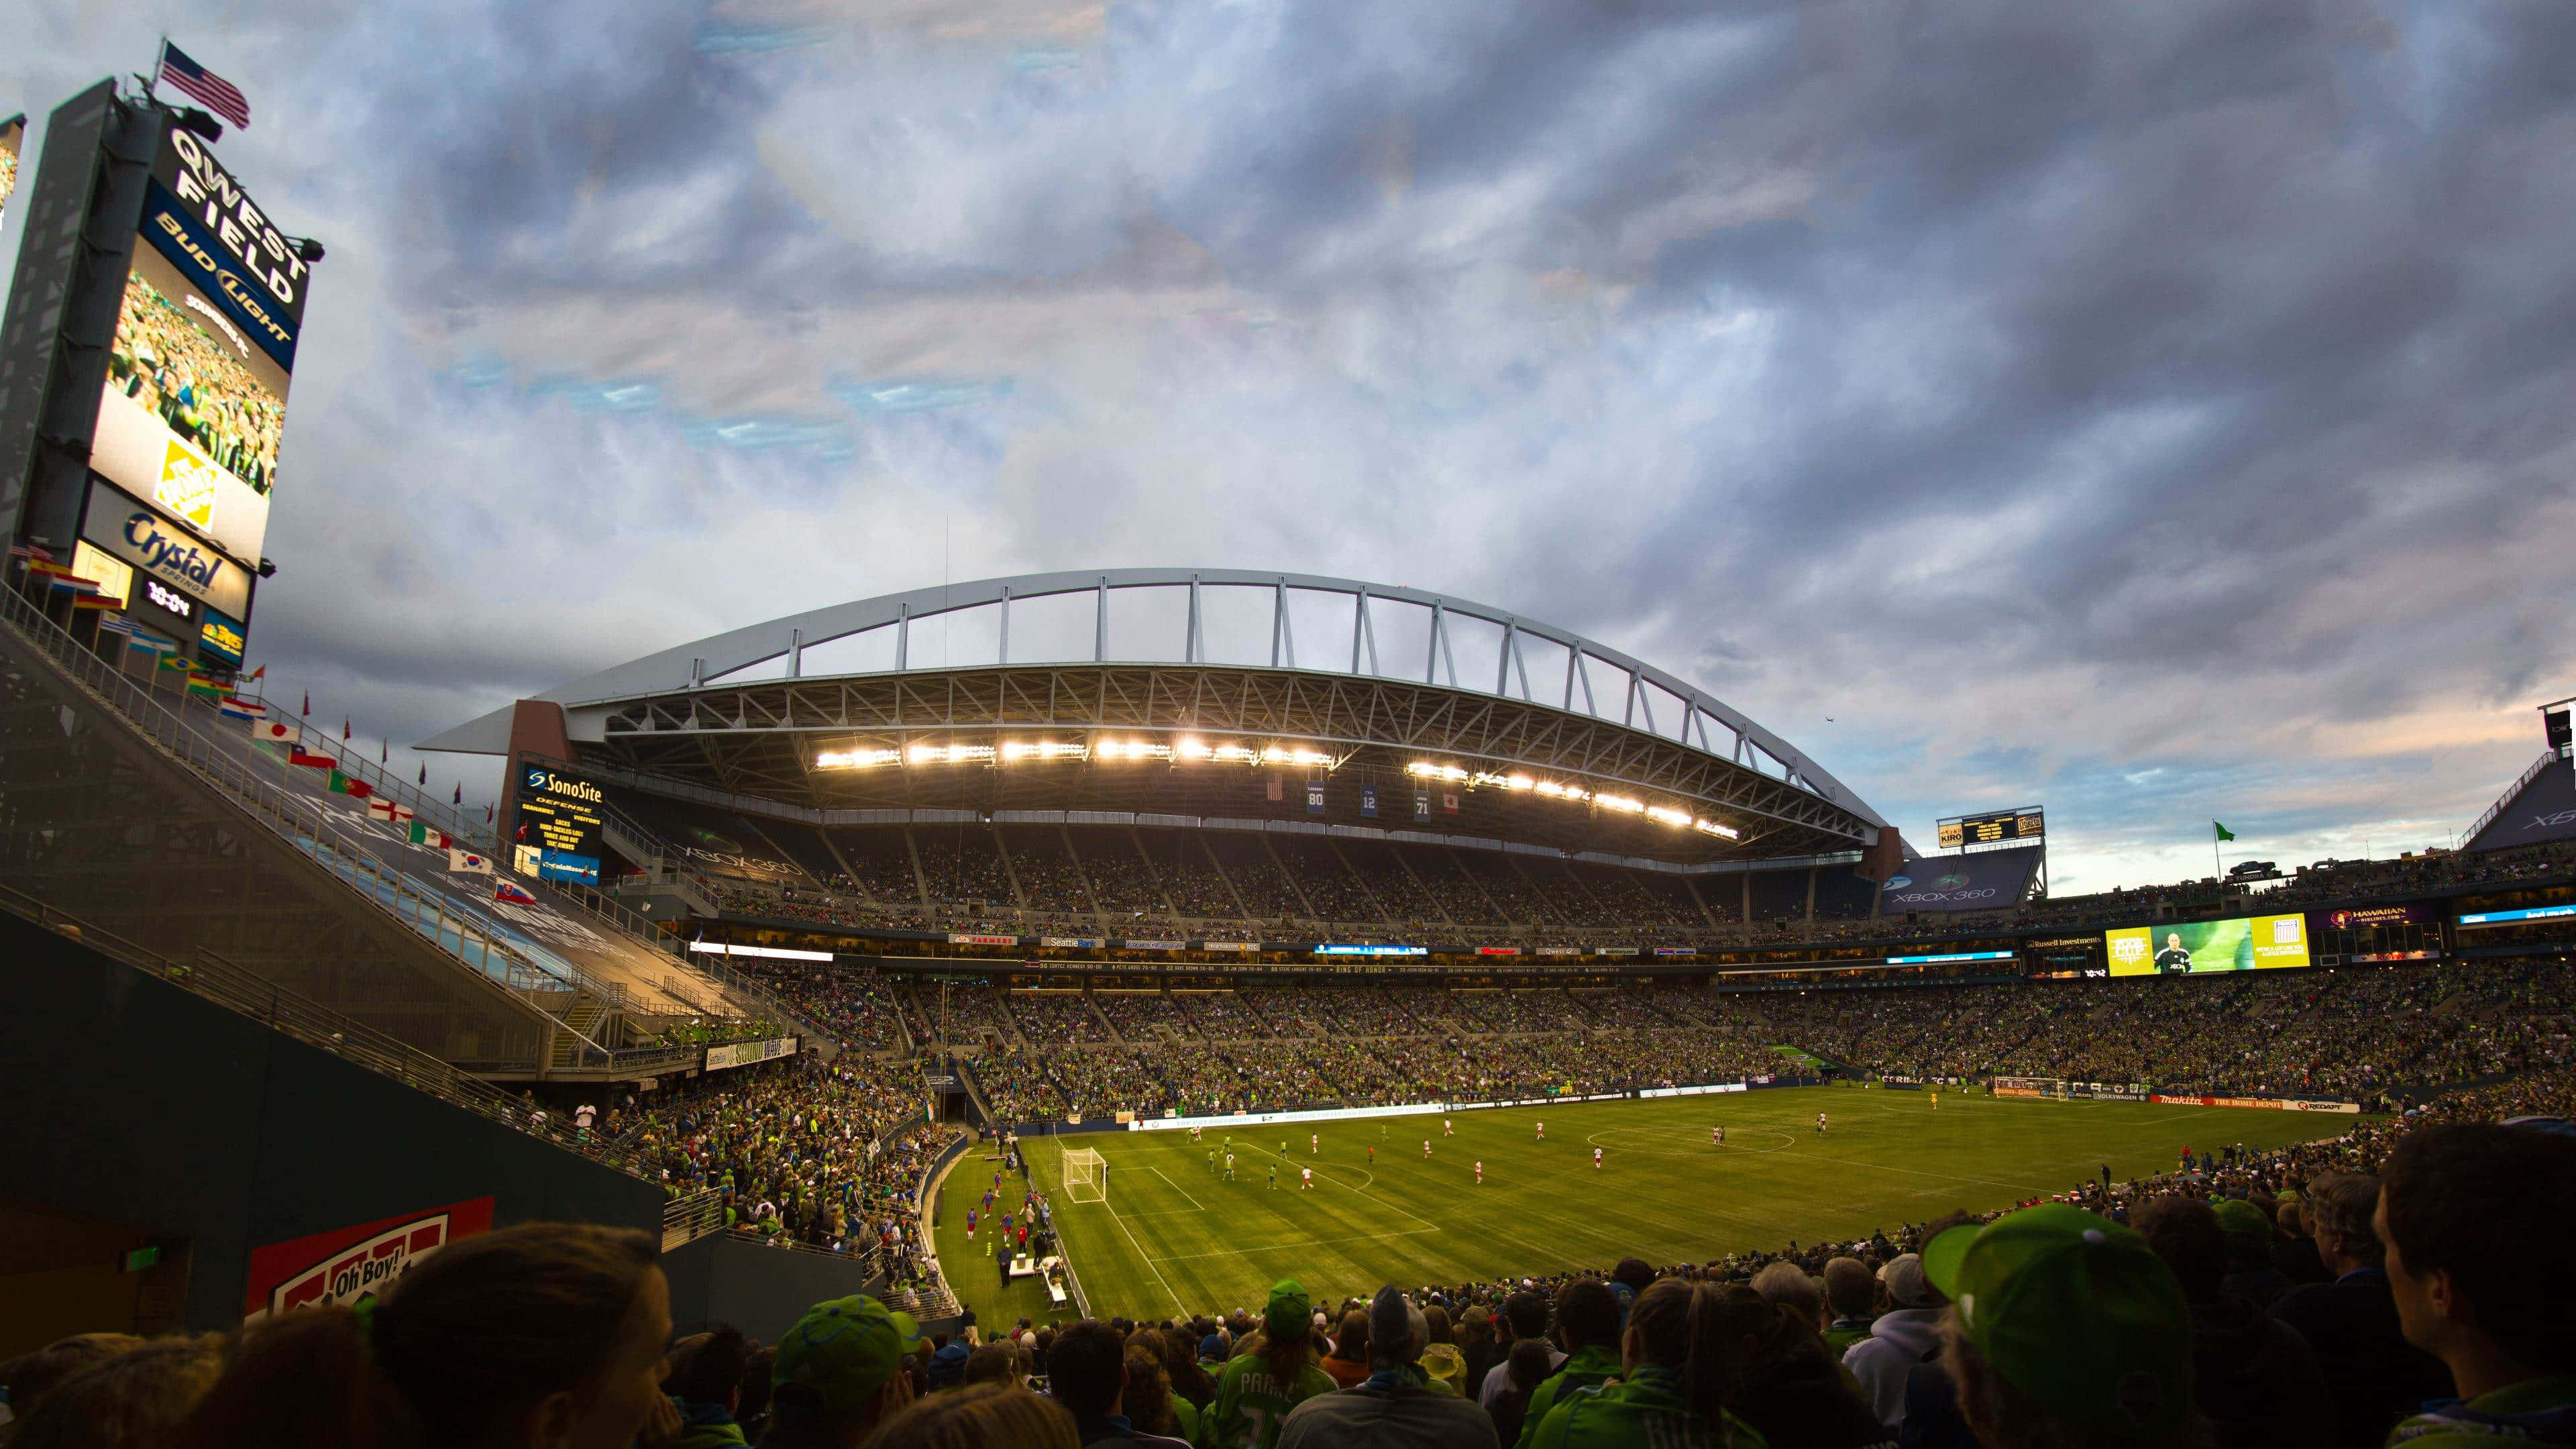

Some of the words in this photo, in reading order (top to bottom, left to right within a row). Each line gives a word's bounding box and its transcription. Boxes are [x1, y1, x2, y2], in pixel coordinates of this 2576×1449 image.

[172, 129, 307, 280] QWEST
[176, 169, 293, 303] FIELD
[155, 212, 217, 272] BUD
[224, 280, 291, 342] LIGHT
[124, 513, 223, 588] Crystal
[161, 569, 208, 595] SPRINGS
[548, 773, 601, 803] SonoSite
[536, 797, 592, 814] DEFENSE
[1309, 794, 1324, 806] 80
[1363, 796, 1375, 809] 12
[1417, 802, 1428, 815] 71
[522, 804, 555, 815] SEAHAWKS
[574, 814, 600, 825] VISITORS
[1941, 834, 1962, 843] KIRO
[751, 858, 802, 875] 360
[1892, 892, 1950, 903] XBOX
[1953, 888, 1996, 900] 360
[2353, 907, 2406, 918] HAWAIIAN
[1051, 938, 1096, 948] SeattleBank
[2059, 936, 2101, 946] Investments
[735, 1042, 763, 1064] SOUND
[764, 1040, 782, 1059] WAVE
[2159, 1095, 2204, 1106] makita
[2231, 1099, 2254, 1108] HOME
[2255, 1100, 2282, 1108] DEPOT
[337, 1266, 360, 1298] Oh
[362, 1248, 399, 1285] Boy!
